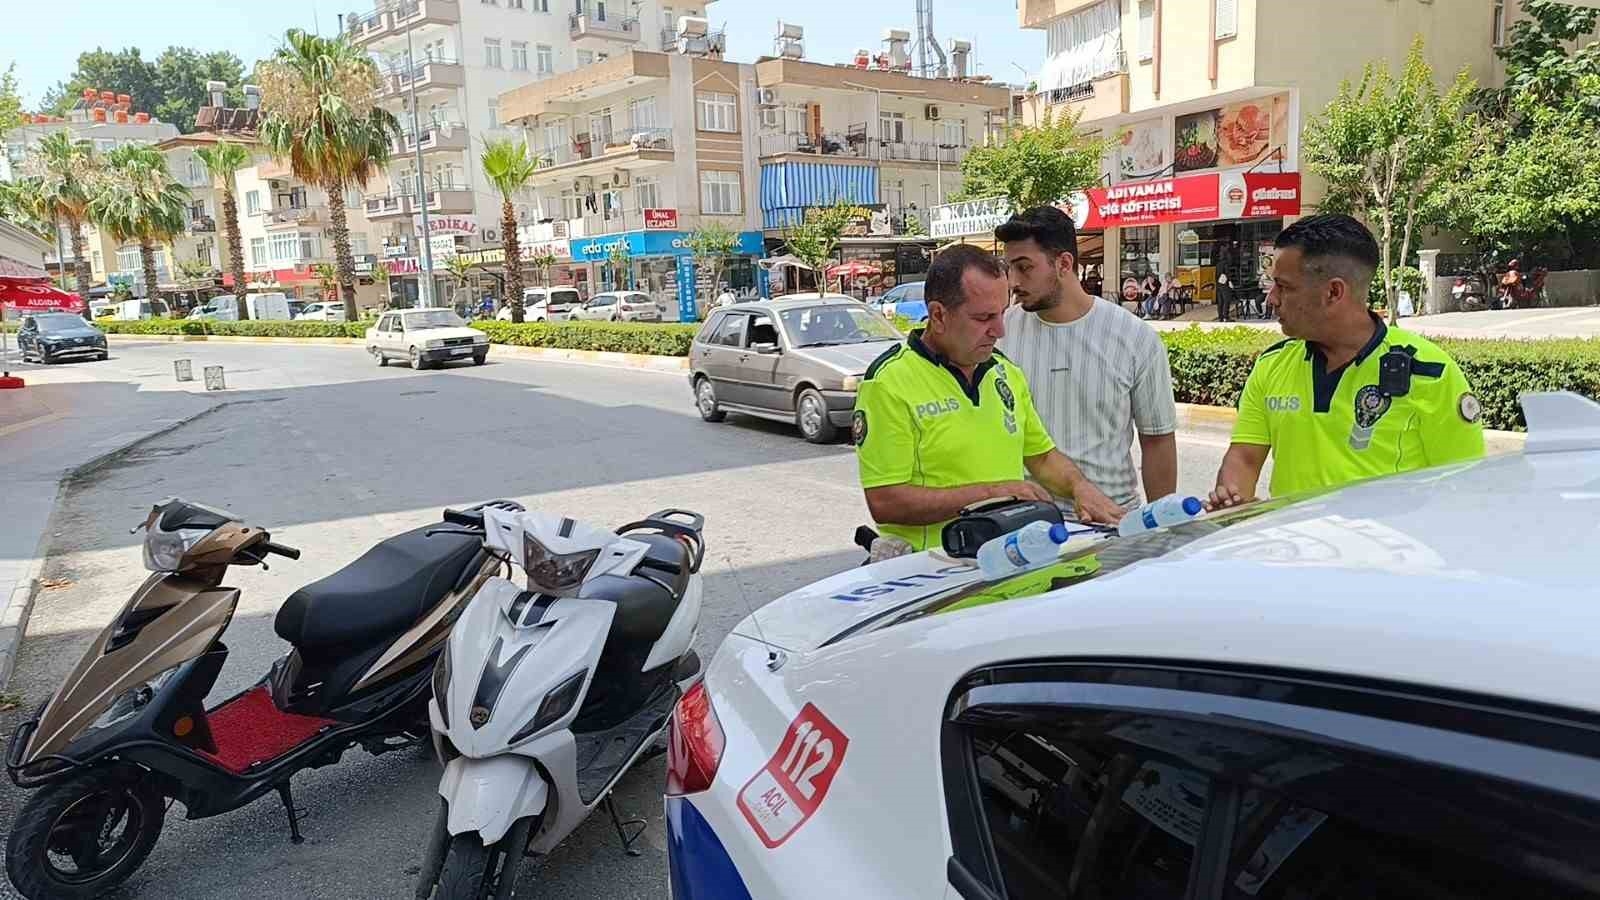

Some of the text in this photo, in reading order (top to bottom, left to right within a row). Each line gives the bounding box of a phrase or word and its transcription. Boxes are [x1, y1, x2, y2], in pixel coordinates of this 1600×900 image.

[1107, 182, 1173, 200] ADIYAMAN
[1120, 196, 1182, 214] KÖFTECİSİ
[582, 239, 601, 255] eda
[915, 397, 960, 418] POLİS
[779, 720, 834, 801] 112
